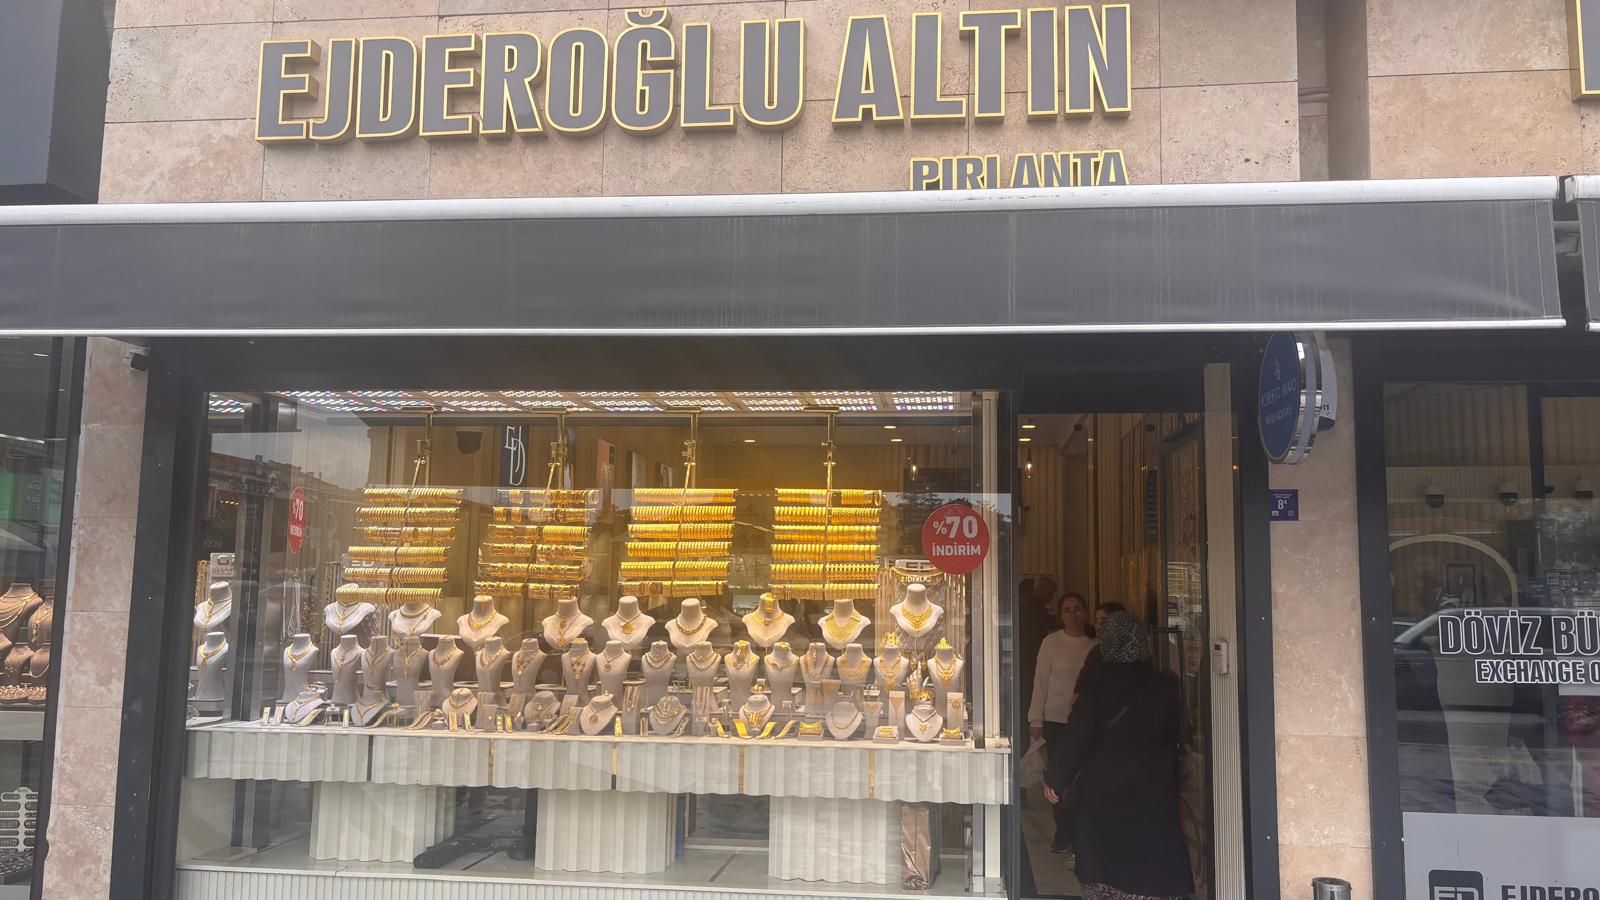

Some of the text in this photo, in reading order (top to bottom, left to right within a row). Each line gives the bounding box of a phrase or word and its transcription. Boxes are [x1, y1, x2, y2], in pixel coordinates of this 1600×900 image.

[255, 3, 1132, 142] EJDEROĞLU ALTIN
[933, 515, 978, 539] %70
[932, 541, 981, 557] İNDİRİM
[1439, 610, 1544, 655] DÖVİZ
[1475, 659, 1585, 684] EXCHANGE
